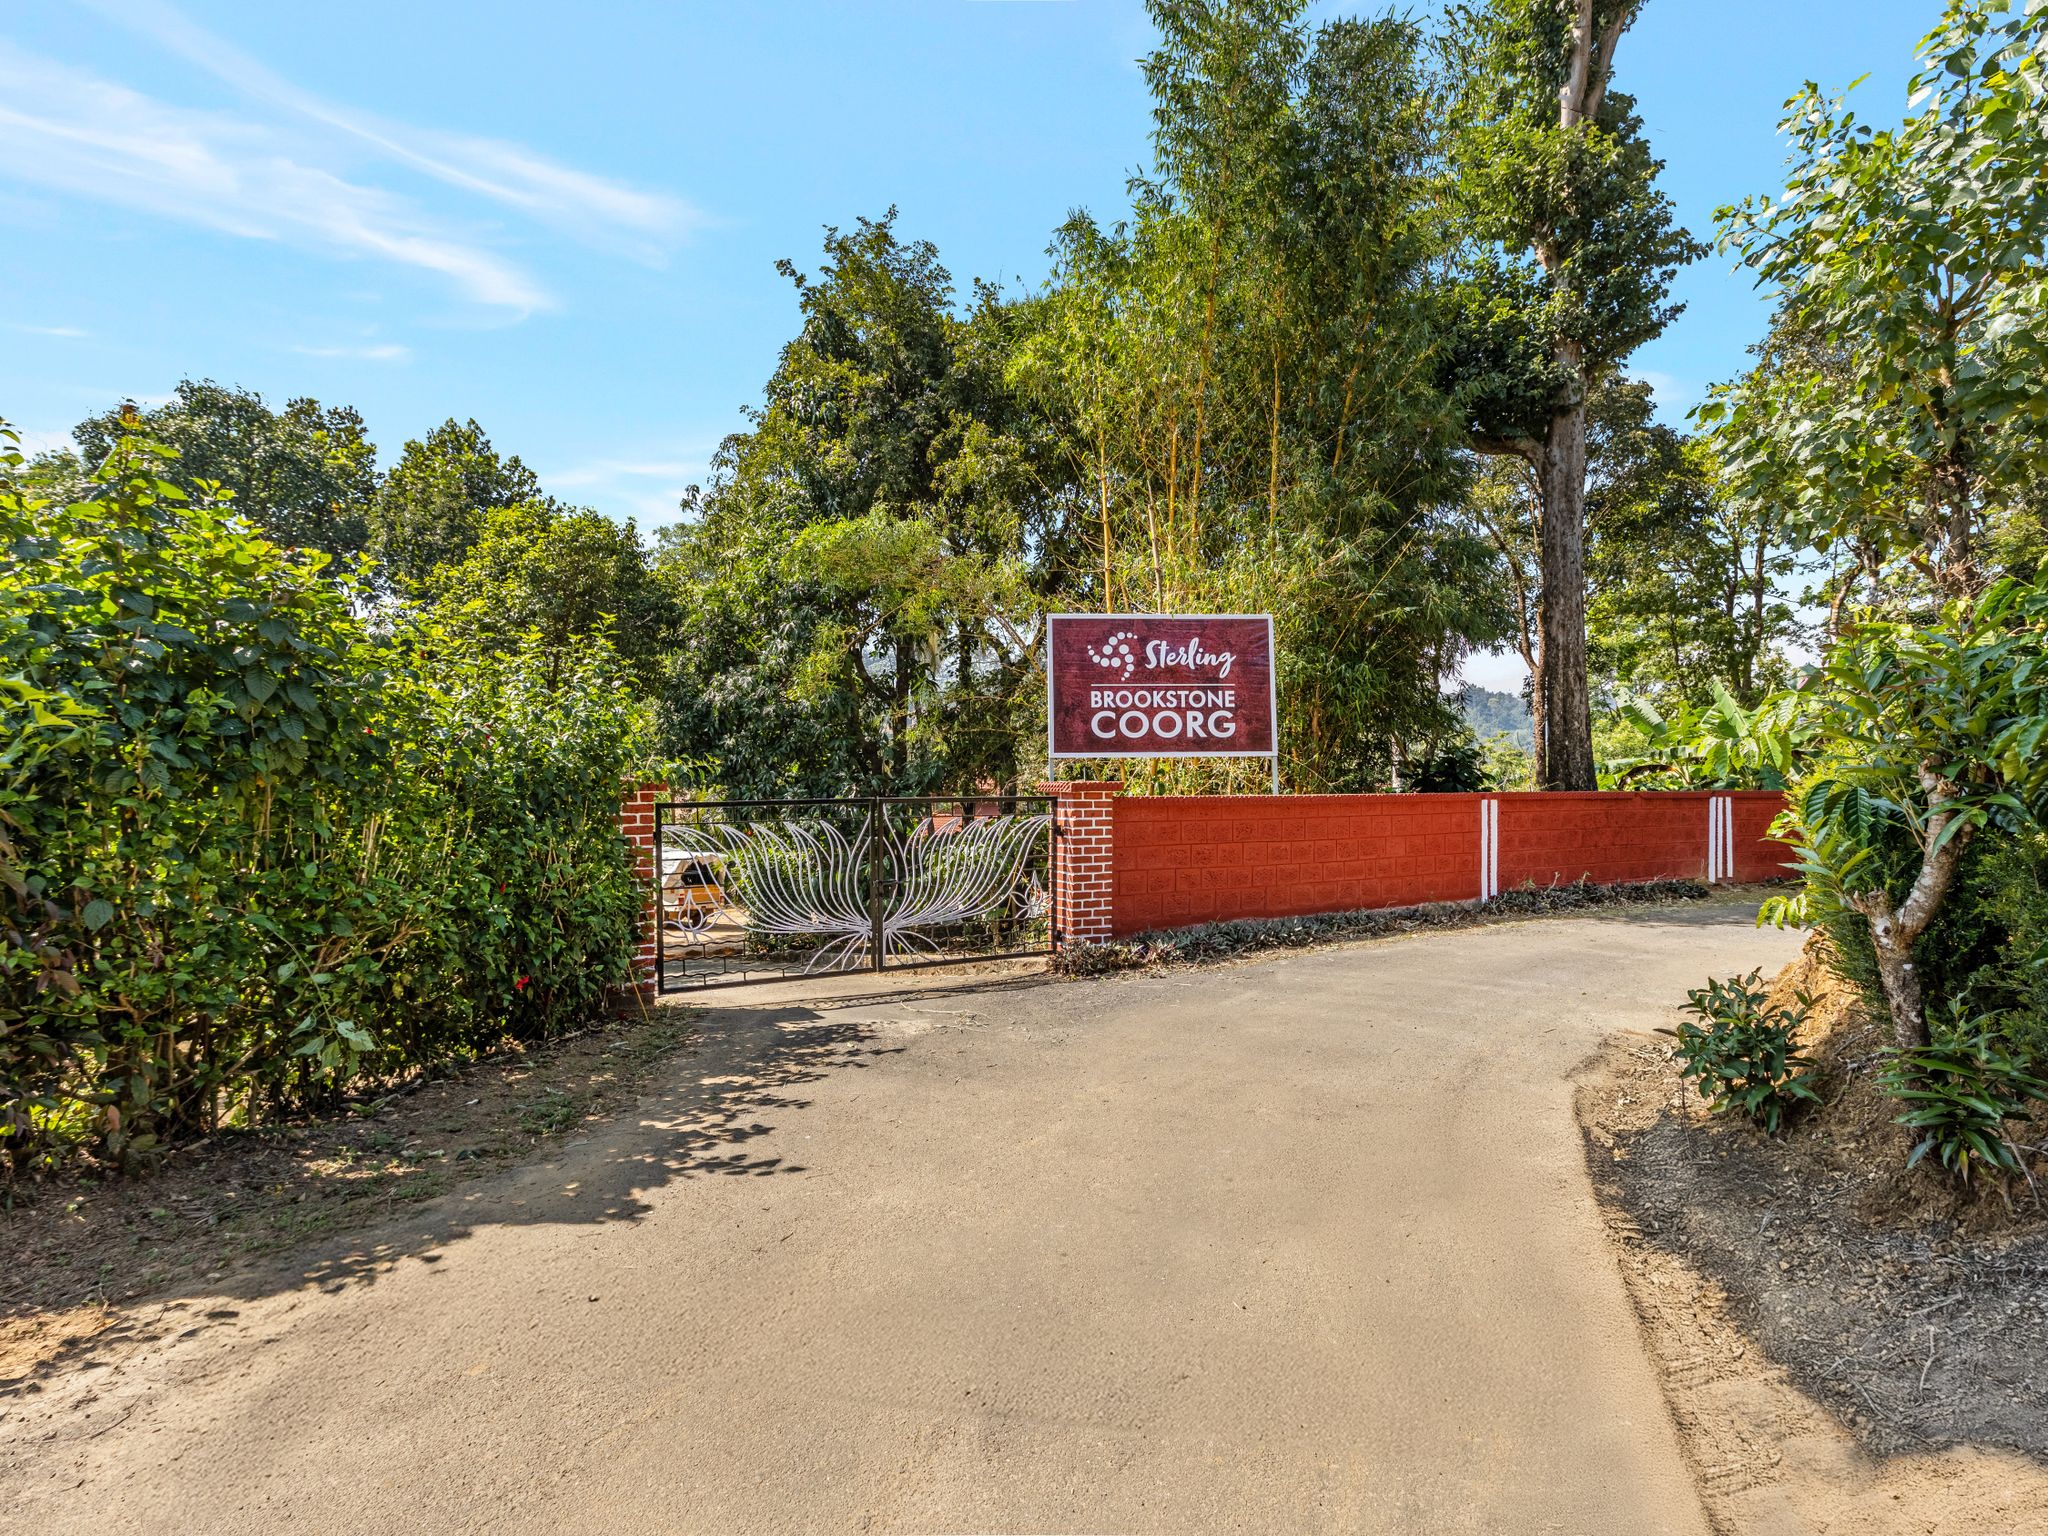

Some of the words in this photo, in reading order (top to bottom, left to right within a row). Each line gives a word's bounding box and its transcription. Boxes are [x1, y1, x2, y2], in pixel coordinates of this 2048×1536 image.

[1145, 637, 1236, 678] Sterling
[1091, 690, 1235, 708] BROOKSTONE
[1091, 710, 1236, 739] COORG
